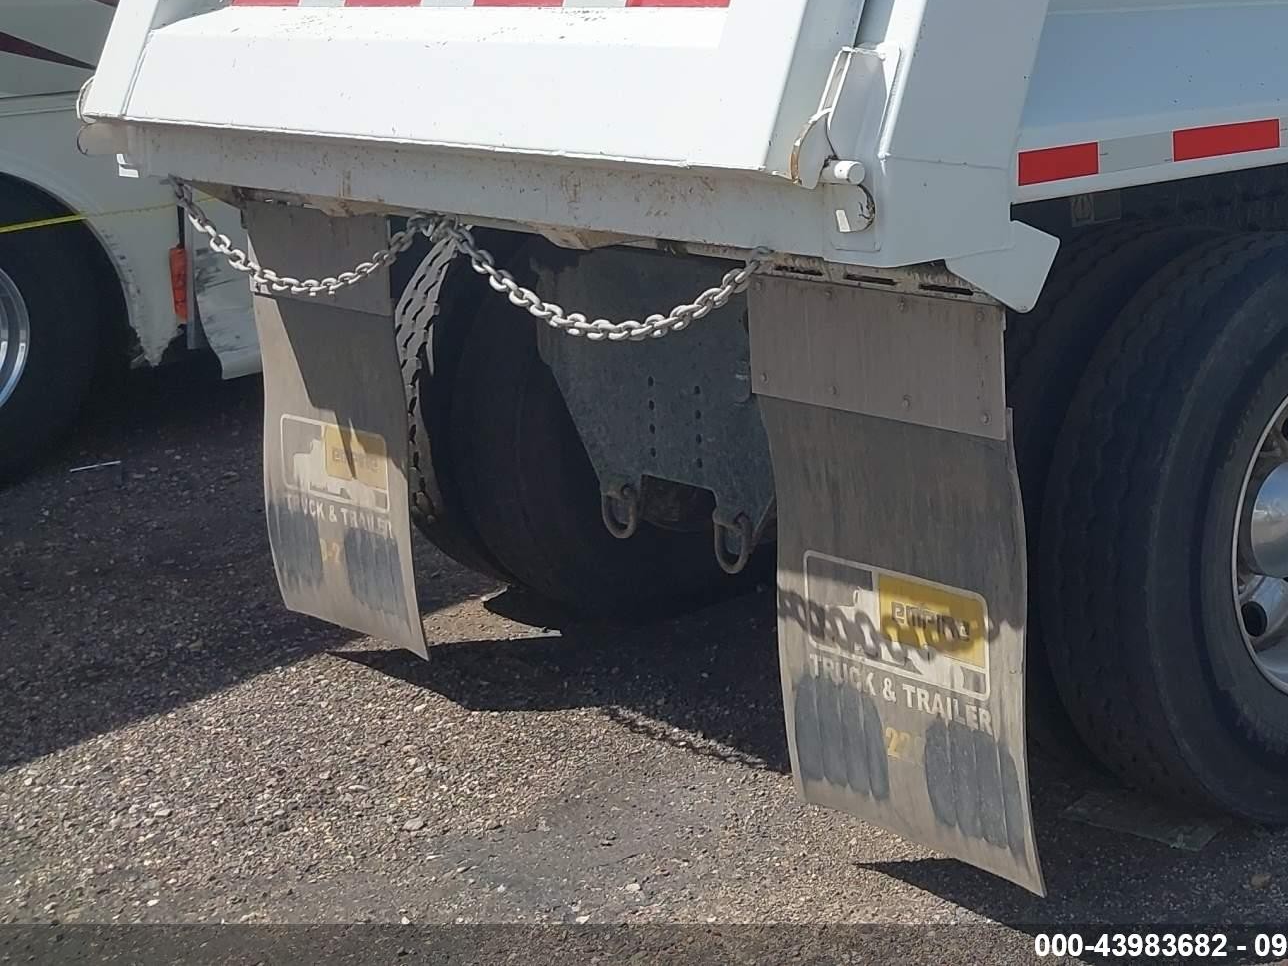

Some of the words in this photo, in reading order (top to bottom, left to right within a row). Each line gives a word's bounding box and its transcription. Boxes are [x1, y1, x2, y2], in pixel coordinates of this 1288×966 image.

[329, 505, 338, 523] &
[809, 653, 877, 696] TRUCK
[883, 678, 897, 703] &
[902, 684, 995, 735] TRAILER
